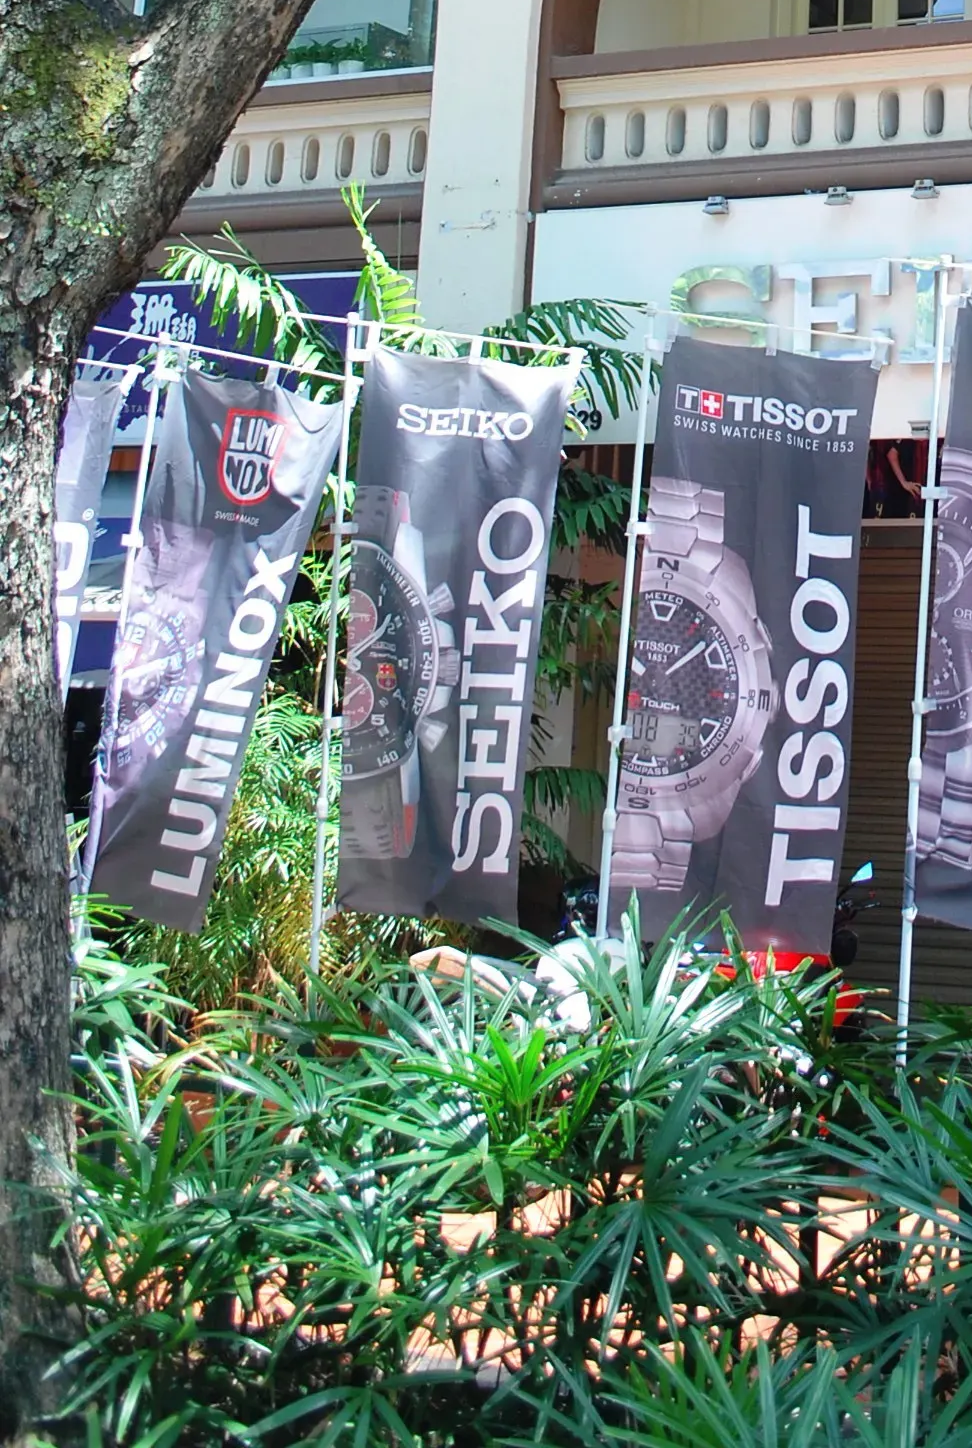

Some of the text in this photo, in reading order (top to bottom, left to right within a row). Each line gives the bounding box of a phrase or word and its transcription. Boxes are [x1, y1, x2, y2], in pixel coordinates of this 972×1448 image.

[396, 403, 534, 441] SEIKO
[673, 414, 855, 453] SWISS WATCHES SINCE 1853
[726, 394, 859, 436] TISSOT
[229, 416, 286, 457] LUMI
[226, 455, 270, 495] NOX
[240, 514, 260, 527] MADE
[637, 639, 681, 655] TISSOT
[710, 624, 738, 682] ALTIMETER
[451, 496, 545, 874] SEIKO
[764, 504, 853, 906] TISSOT
[150, 547, 299, 898] LUMINOX
[700, 714, 733, 758] CHRONO
